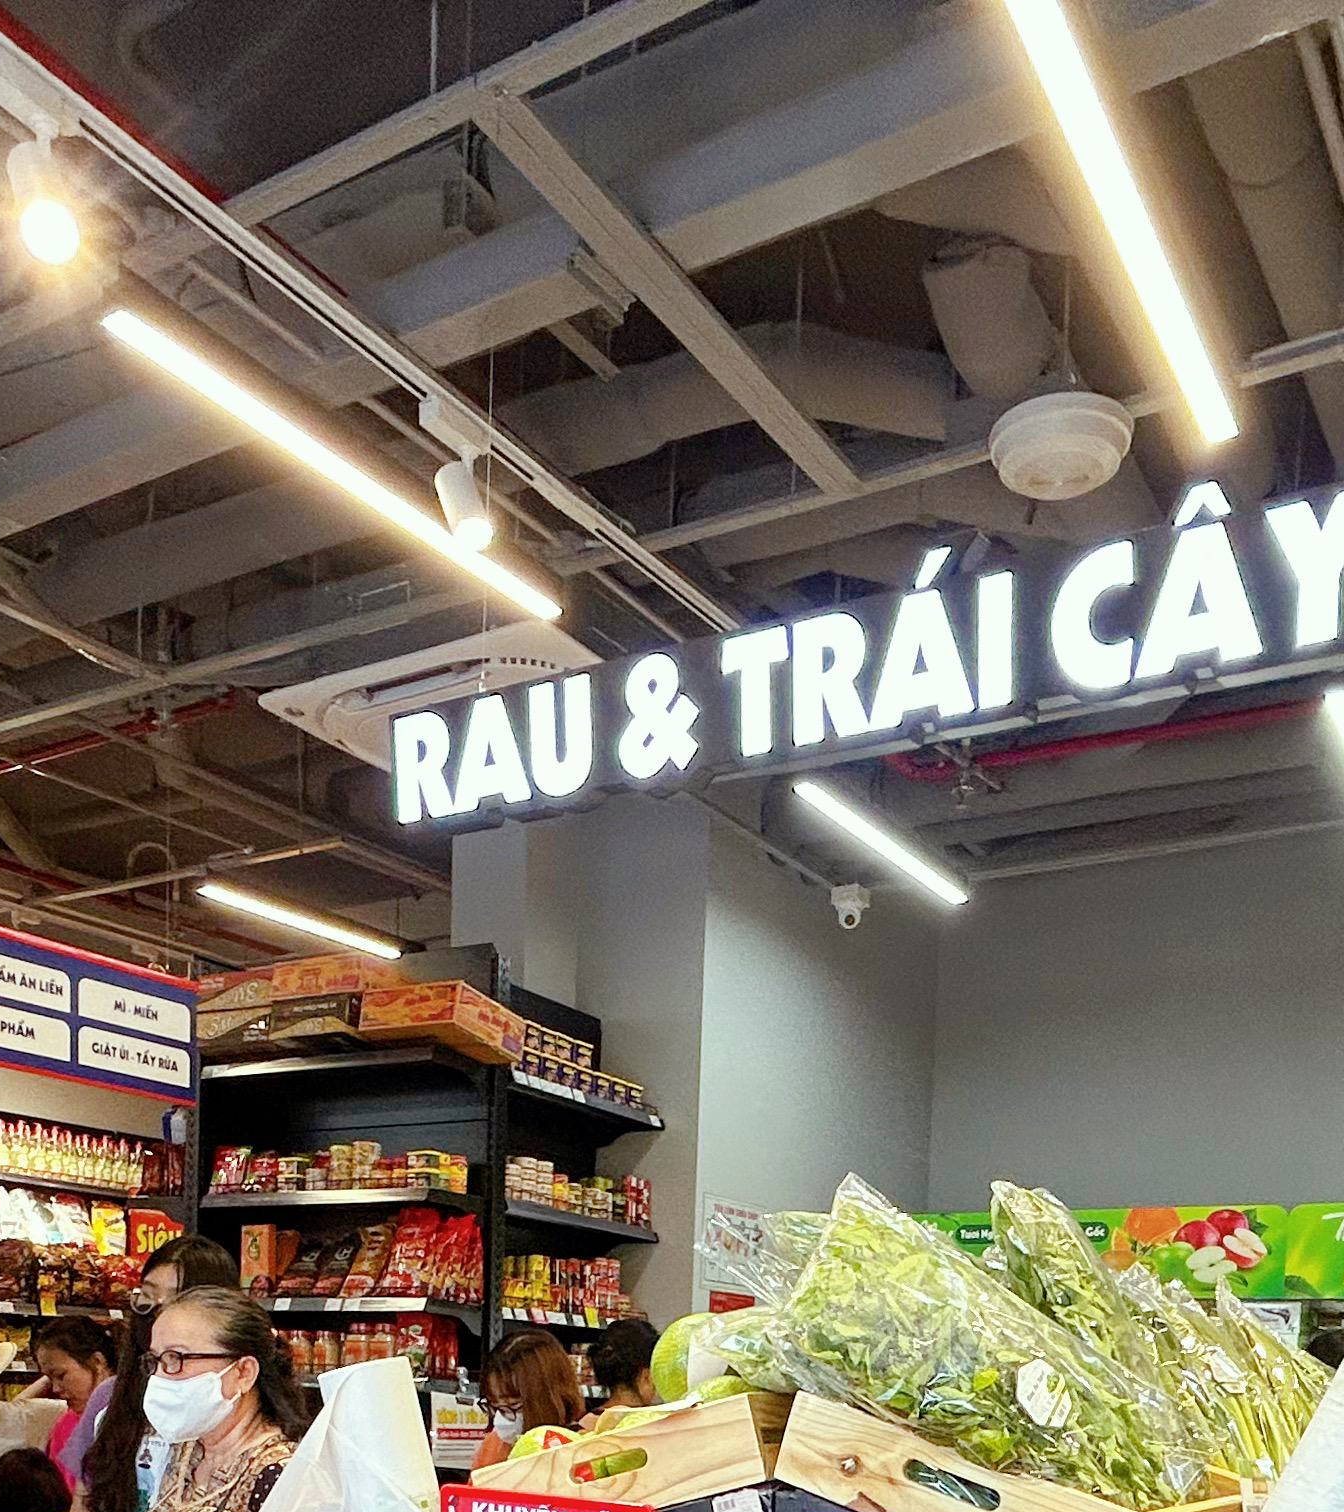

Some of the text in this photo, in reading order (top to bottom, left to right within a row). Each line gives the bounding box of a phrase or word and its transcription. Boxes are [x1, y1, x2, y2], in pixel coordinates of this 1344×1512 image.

[391, 679, 594, 826] RAU
[618, 653, 702, 778] &
[719, 545, 1019, 758] TRÁI
[19, 972, 37, 990] ĂN
[137, 1222, 182, 1254] Siê
